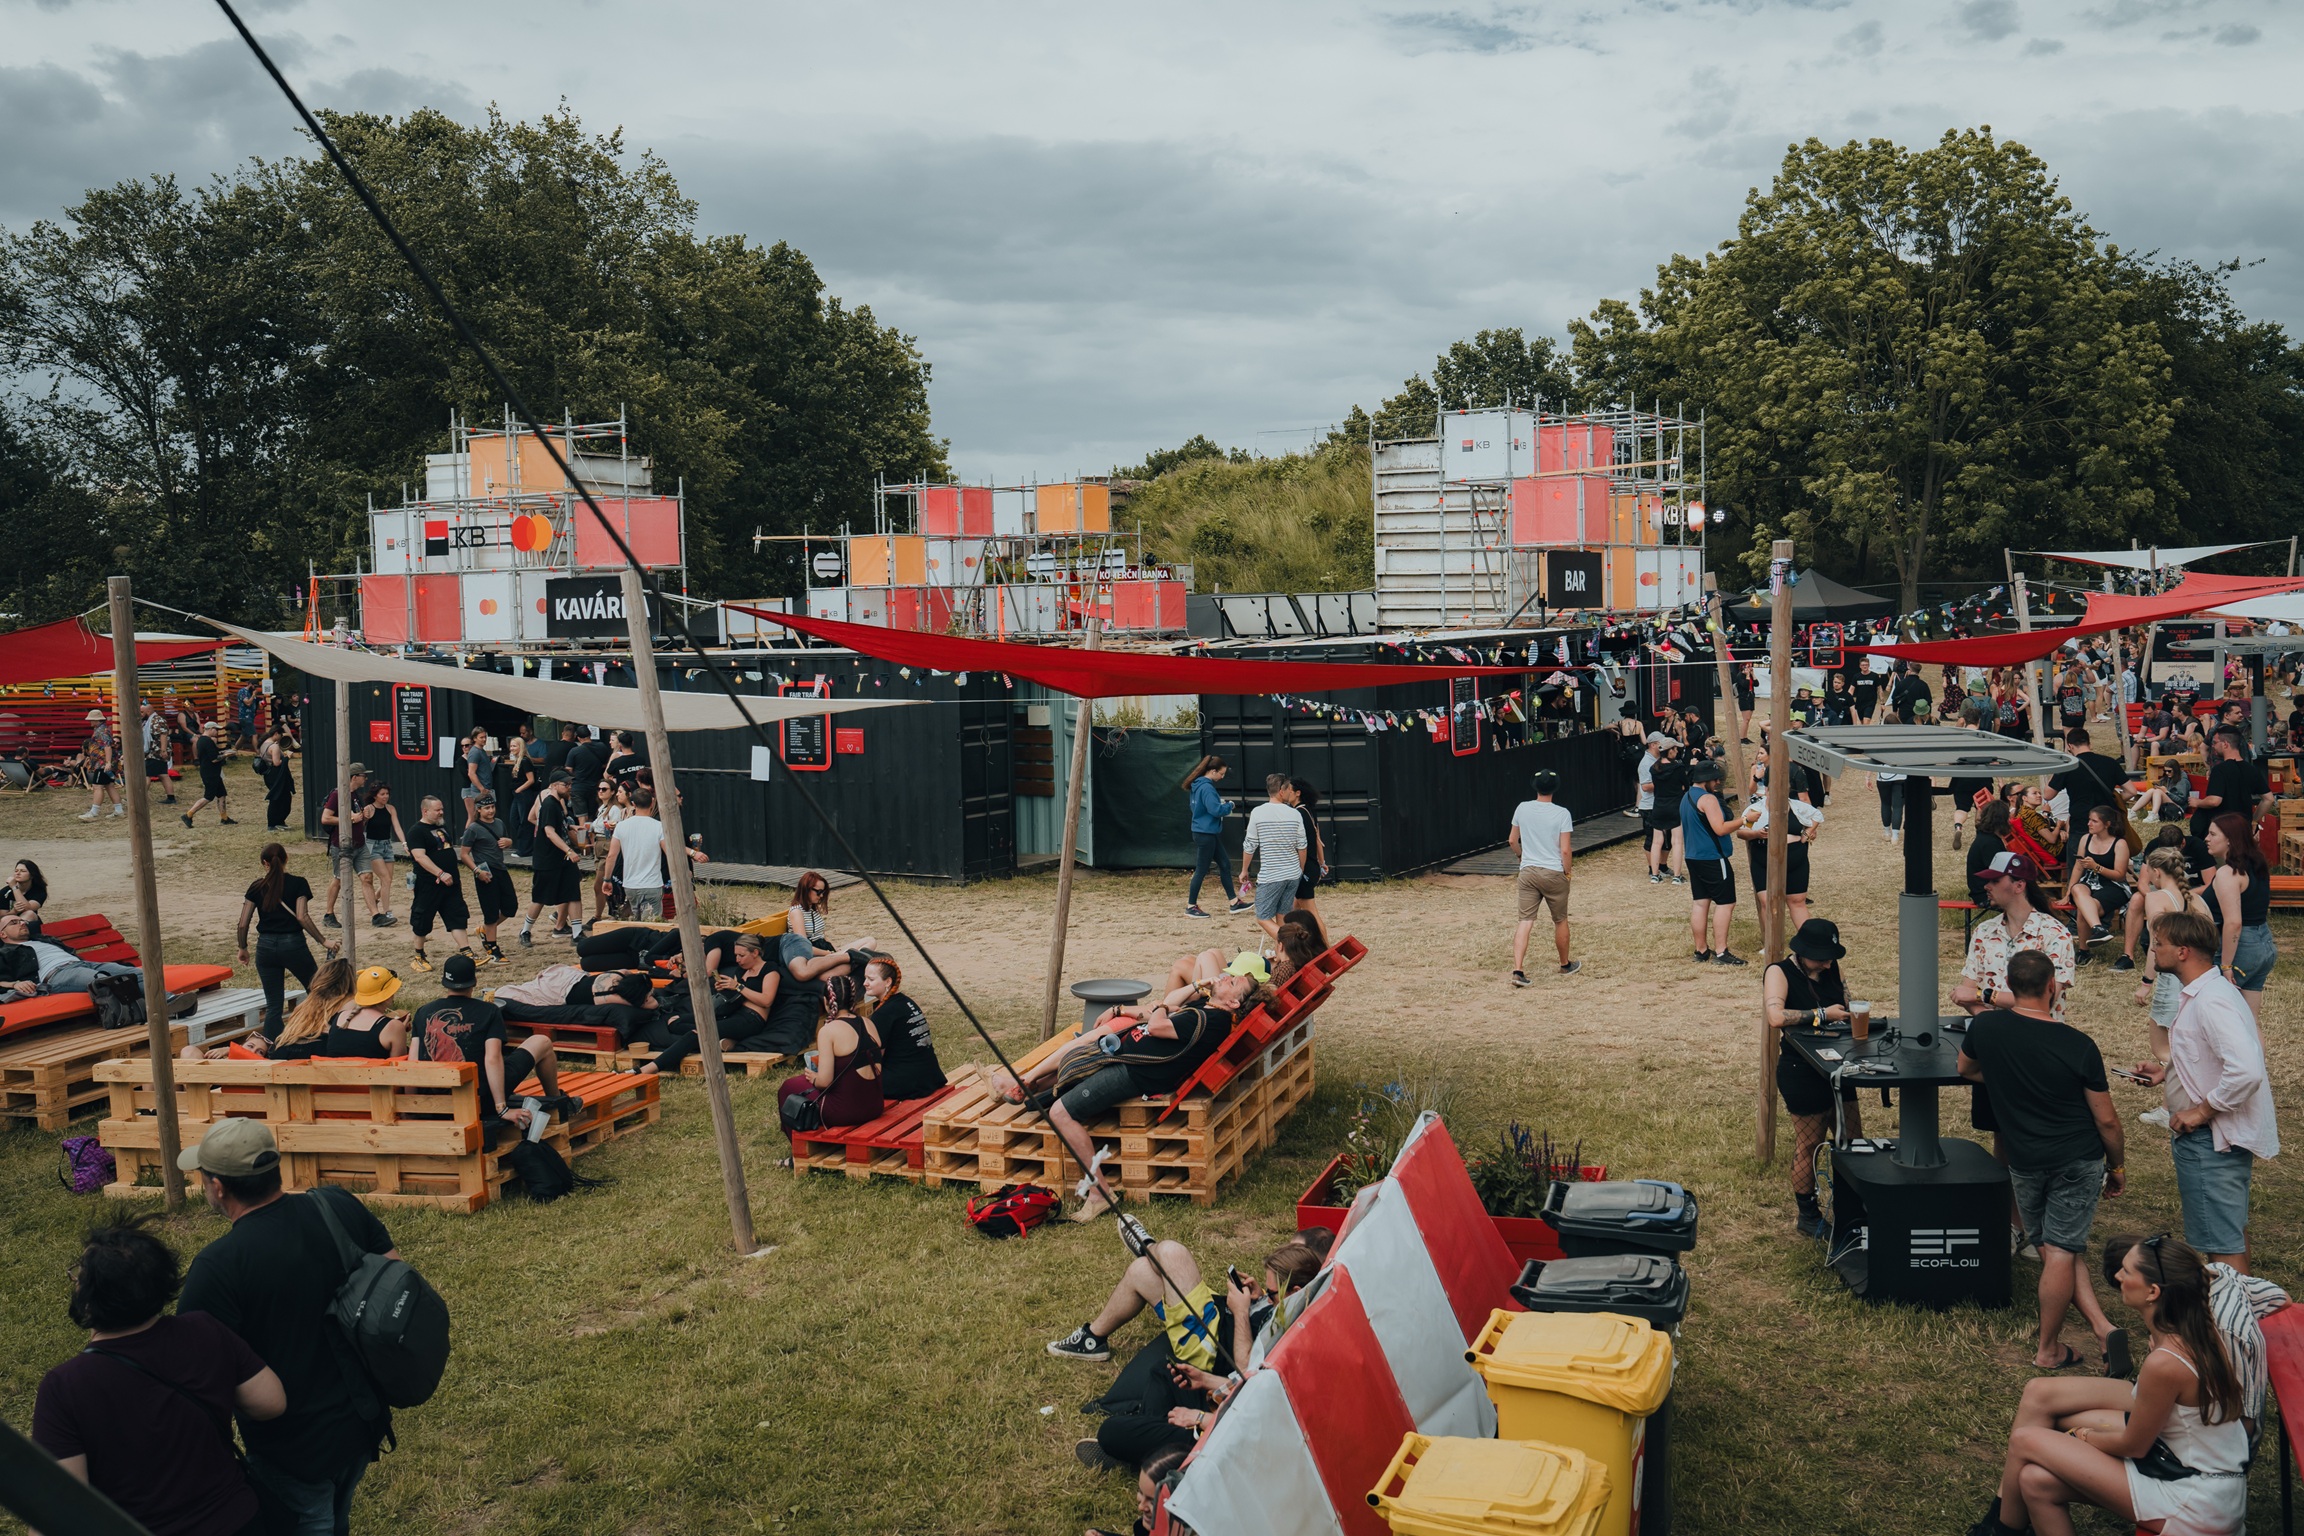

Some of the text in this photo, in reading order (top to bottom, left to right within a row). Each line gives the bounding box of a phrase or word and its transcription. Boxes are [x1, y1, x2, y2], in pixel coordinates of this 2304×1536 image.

[1476, 441, 1490, 449] KB
[1663, 505, 1679, 525] KB
[455, 526, 486, 548] KB
[1565, 570, 1586, 591] BAR
[2245, 645, 2296, 653] ECOFLOW
[1910, 1259, 1979, 1267] ECOFLOW
